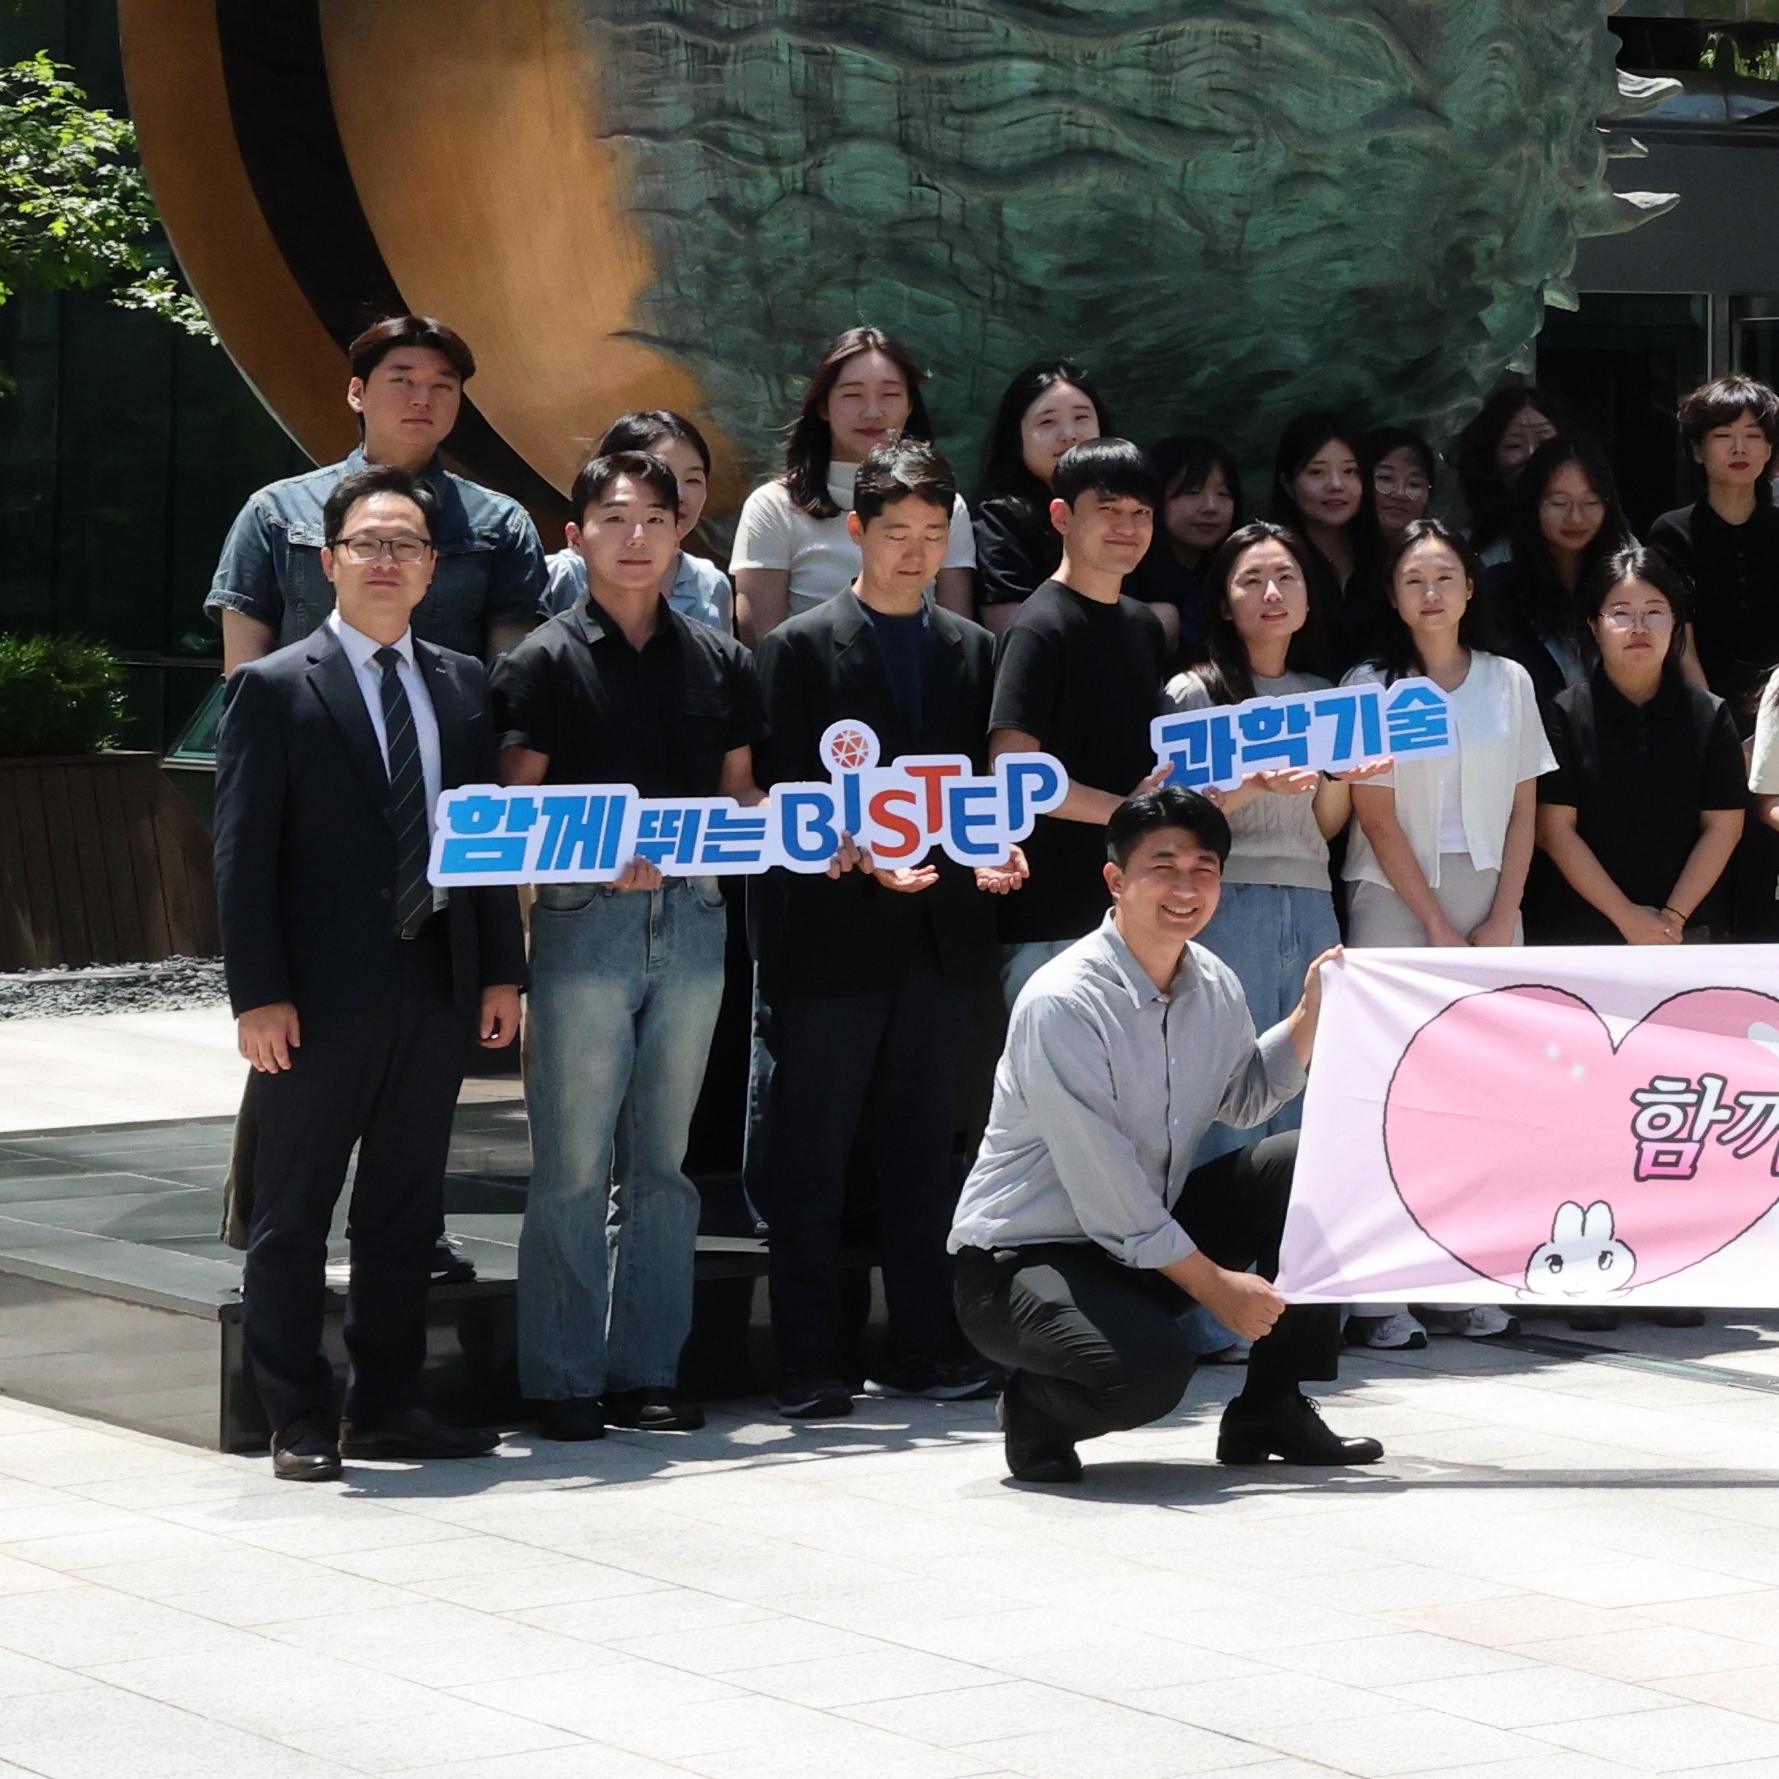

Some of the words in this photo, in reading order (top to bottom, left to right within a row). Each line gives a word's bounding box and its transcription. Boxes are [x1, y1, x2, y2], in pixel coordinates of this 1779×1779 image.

[1162, 686, 1449, 787] 과학기술
[440, 794, 629, 874] 함께
[635, 807, 767, 864] 뛰는
[780, 762, 1059, 862] BISTEP
